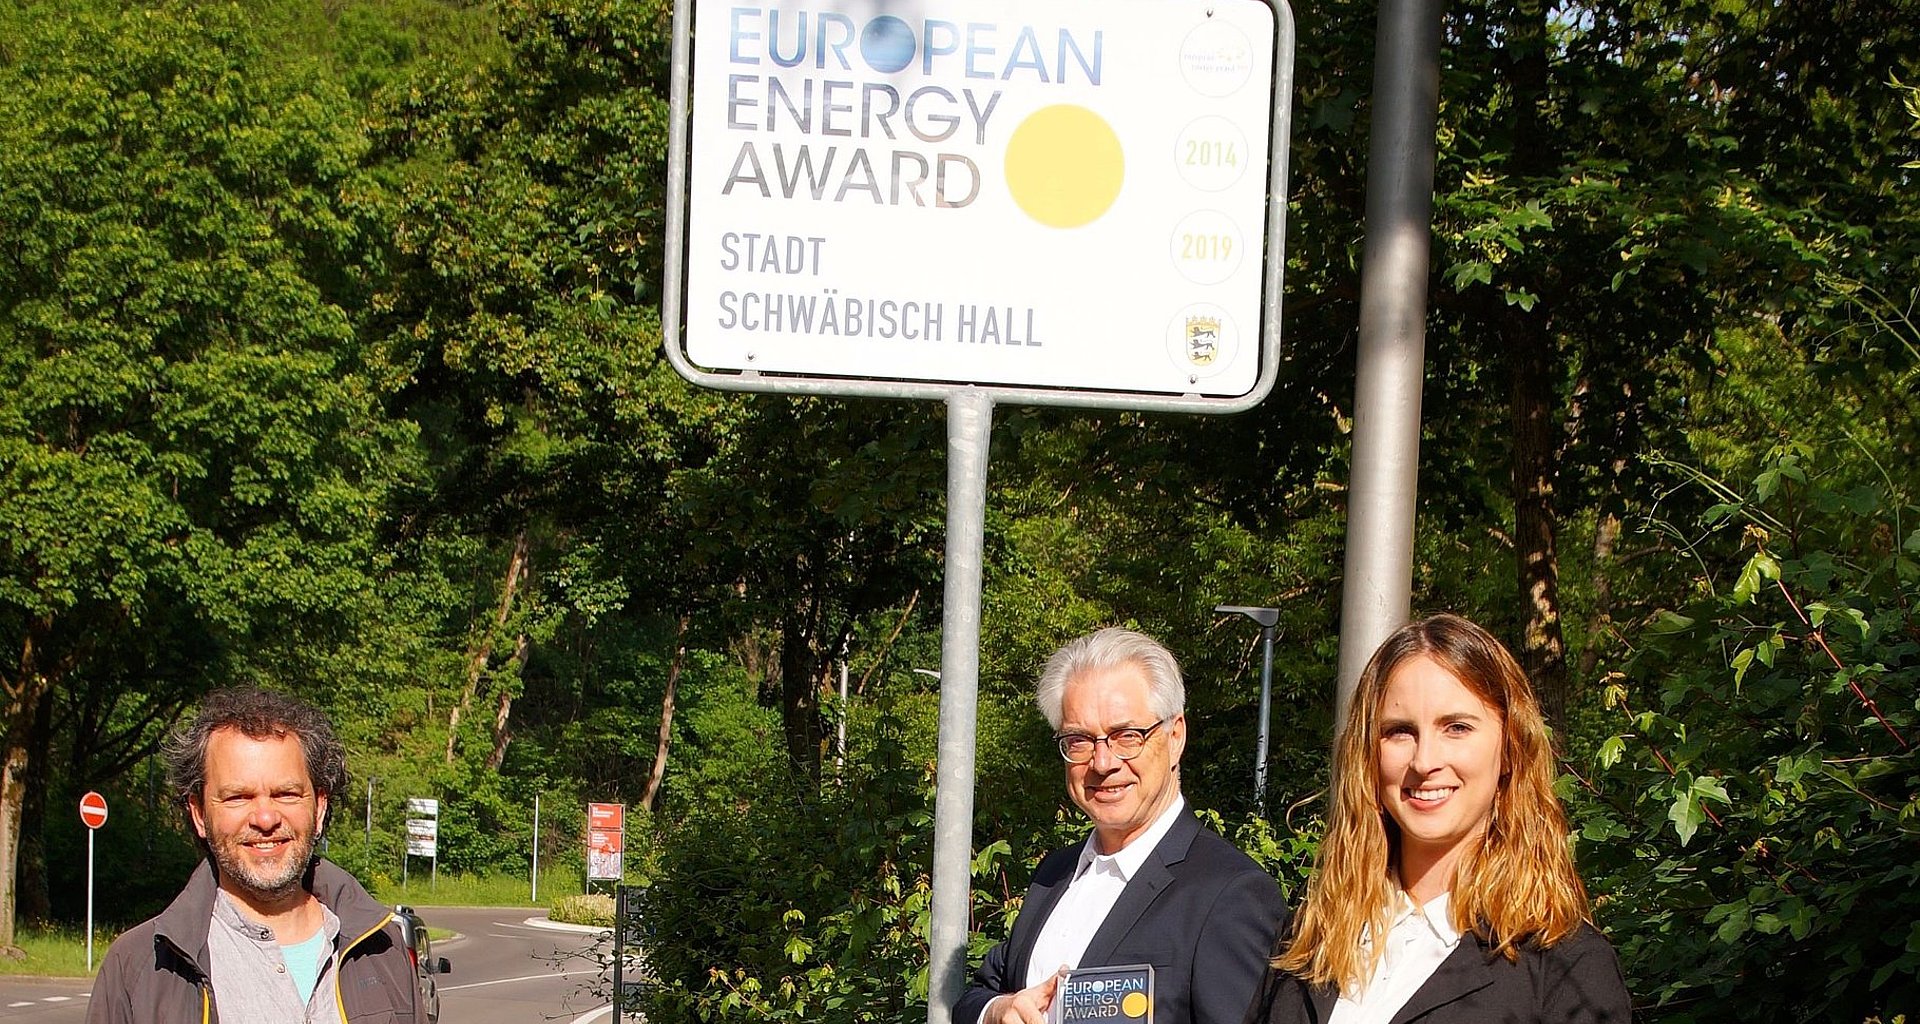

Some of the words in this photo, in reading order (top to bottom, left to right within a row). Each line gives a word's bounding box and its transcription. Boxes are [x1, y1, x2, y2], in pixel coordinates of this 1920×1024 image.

[729, 7, 1103, 86] EUROPEAN
[727, 74, 1003, 145] ENERGY
[1186, 140, 1237, 168] 2014
[721, 141, 981, 209] AWARD
[720, 232, 826, 276] STADT
[1182, 233, 1233, 260] 2019
[718, 288, 943, 341] SCHWÄBISCH
[957, 304, 1042, 347] HALL
[1064, 992, 1122, 1007] ENERGY
[1065, 978, 1144, 994] EUROPEAN
[1064, 1005, 1119, 1020] AWARD
